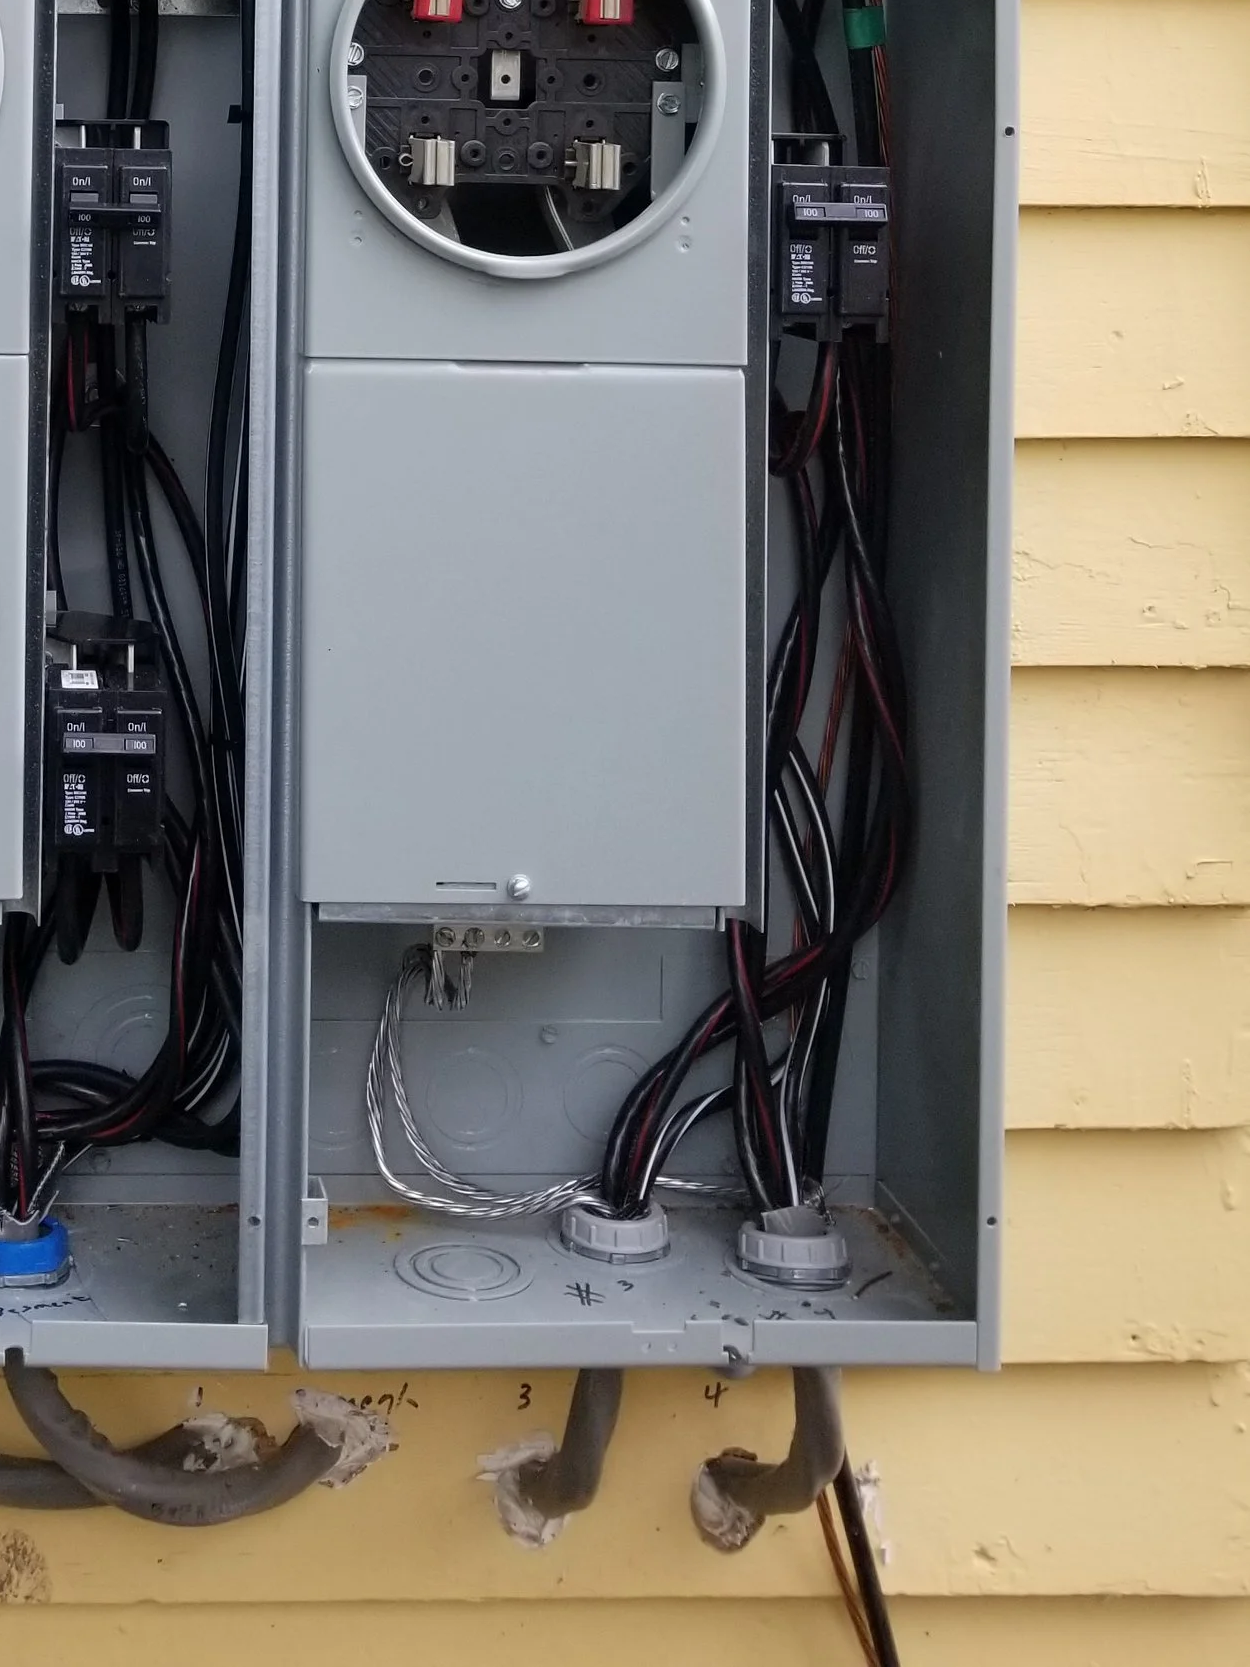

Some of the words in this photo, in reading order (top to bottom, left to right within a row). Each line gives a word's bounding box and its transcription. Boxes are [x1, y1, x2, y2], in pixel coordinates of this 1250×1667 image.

[804, 208, 818, 216] 100
[864, 210, 878, 218] 100
[78, 214, 91, 222] 100
[72, 740, 86, 748] 100
[134, 740, 147, 750] 100
[564, 1282, 606, 1306] #
[617, 1280, 634, 1292] 3
[517, 1382, 532, 1410] 3
[704, 1382, 729, 1408] 4
